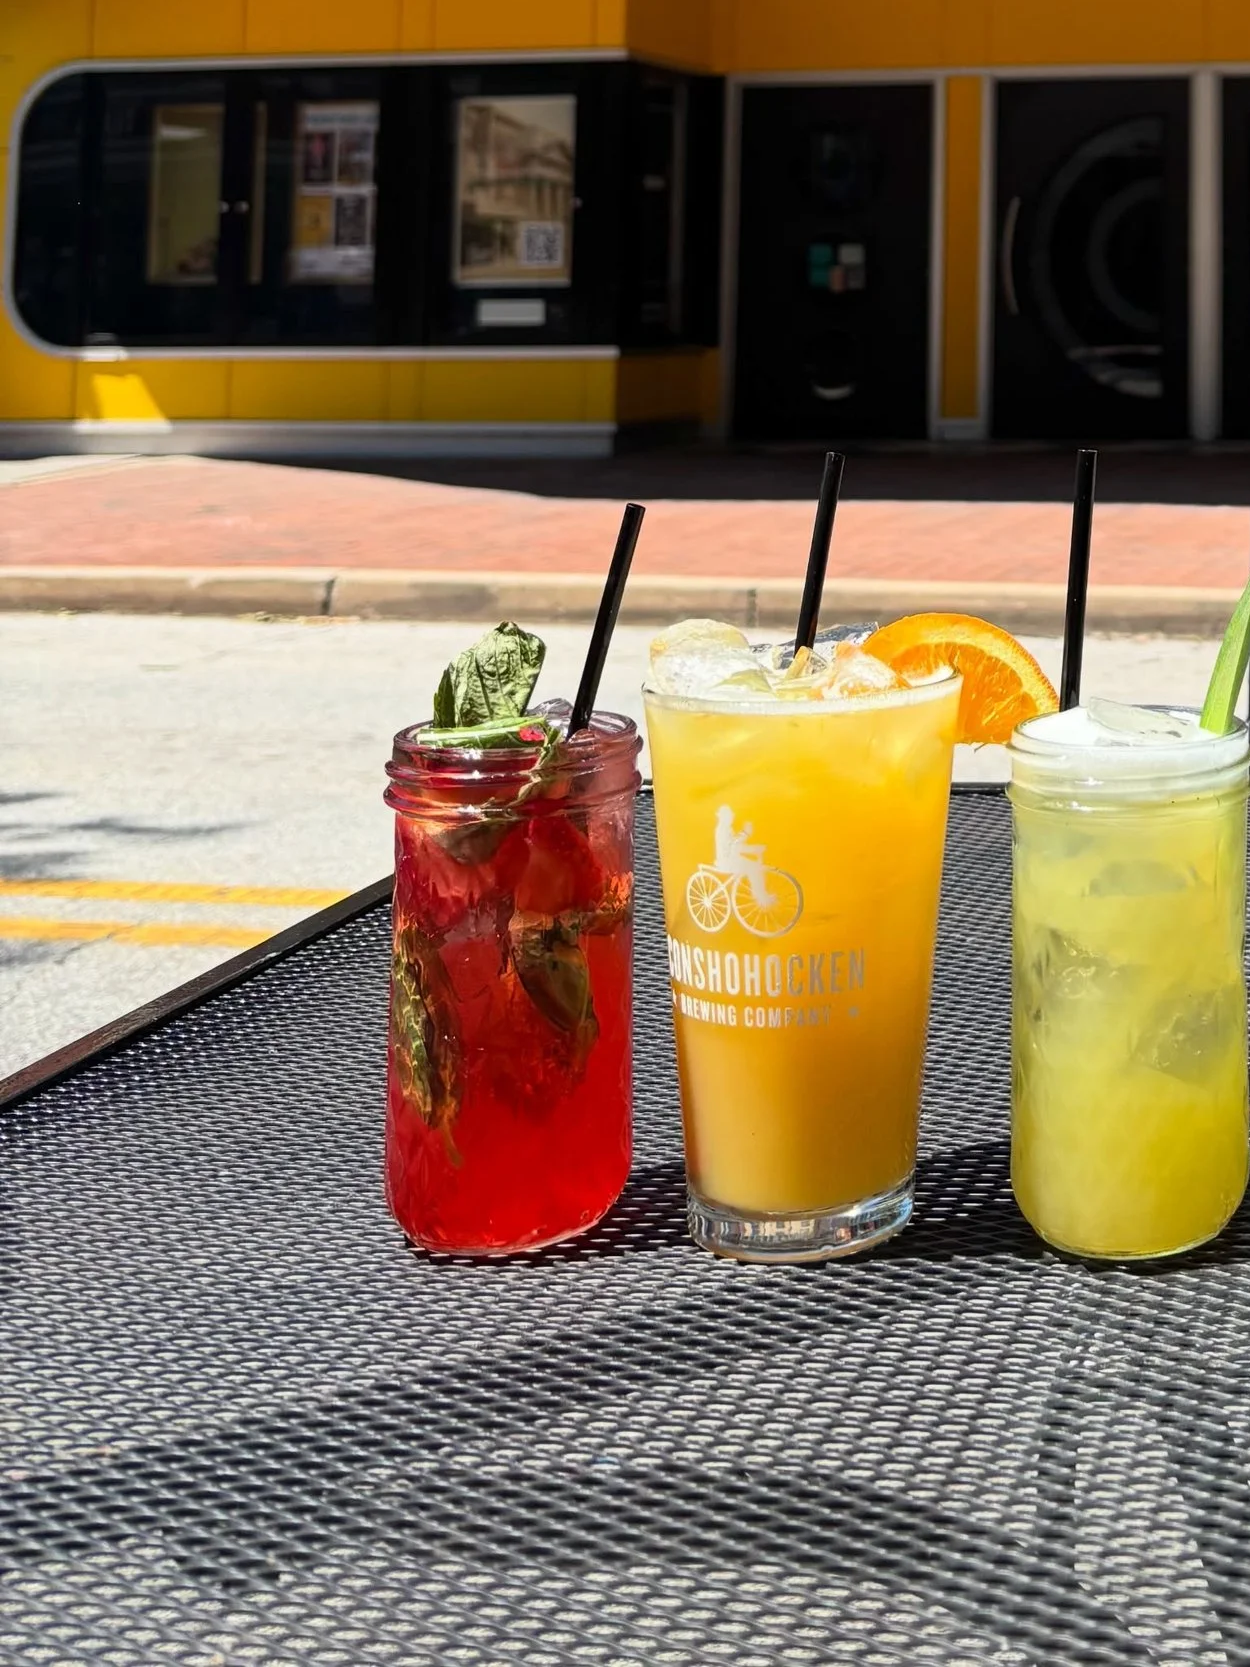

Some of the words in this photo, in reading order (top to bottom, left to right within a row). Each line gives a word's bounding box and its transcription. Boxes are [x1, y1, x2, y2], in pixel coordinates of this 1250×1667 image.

[667, 933, 866, 998] CONSHOHOCKEN
[680, 992, 737, 1027] BREWING
[744, 1005, 832, 1029] COMPANY
